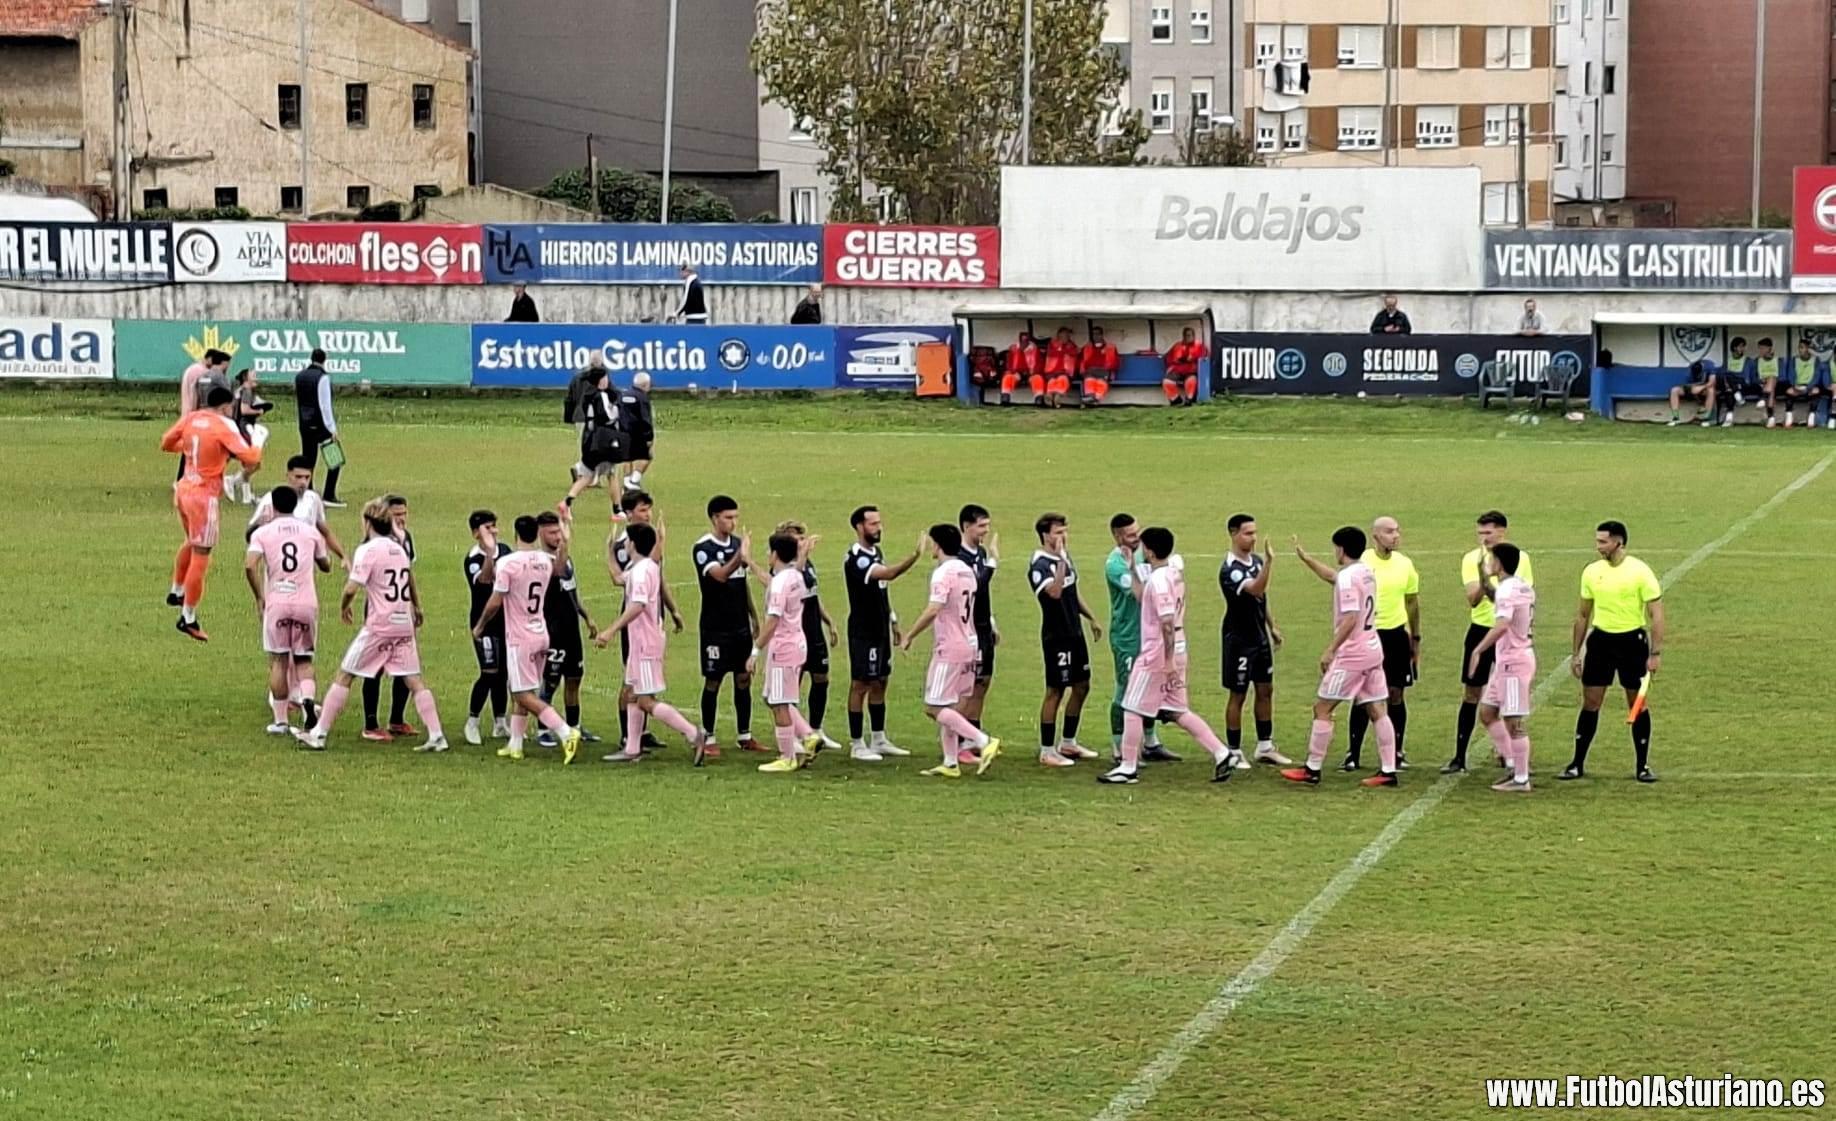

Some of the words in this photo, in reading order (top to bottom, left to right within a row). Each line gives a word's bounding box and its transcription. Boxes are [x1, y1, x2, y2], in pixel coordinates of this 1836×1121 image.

[1155, 192, 1364, 255] Baldajos
[60, 228, 168, 273] MUELLE
[246, 231, 273, 245] VIA
[845, 230, 978, 256] CIERRES
[236, 246, 284, 259] APPIA
[289, 242, 355, 265] COLCHON
[540, 240, 618, 266] HIERROS
[623, 241, 726, 266] LAMINADOS
[731, 241, 818, 266] ASTURIAS
[1495, 244, 1619, 277] VENTANAS
[1628, 237, 1783, 278] CASTRILLÓN
[836, 256, 985, 282] GUERRAS
[250, 330, 314, 353] CAJA
[318, 331, 405, 353] RURAL
[602, 339, 706, 370] Galicia
[254, 358, 277, 372] DE
[1363, 348, 1438, 371] SEGUNDA
[282, 542, 298, 573] 8
[384, 568, 411, 603] 32
[527, 581, 542, 615] 5
[548, 648, 566, 663] 22
[1057, 651, 1071, 667] 21
[1238, 656, 1248, 671] 2
